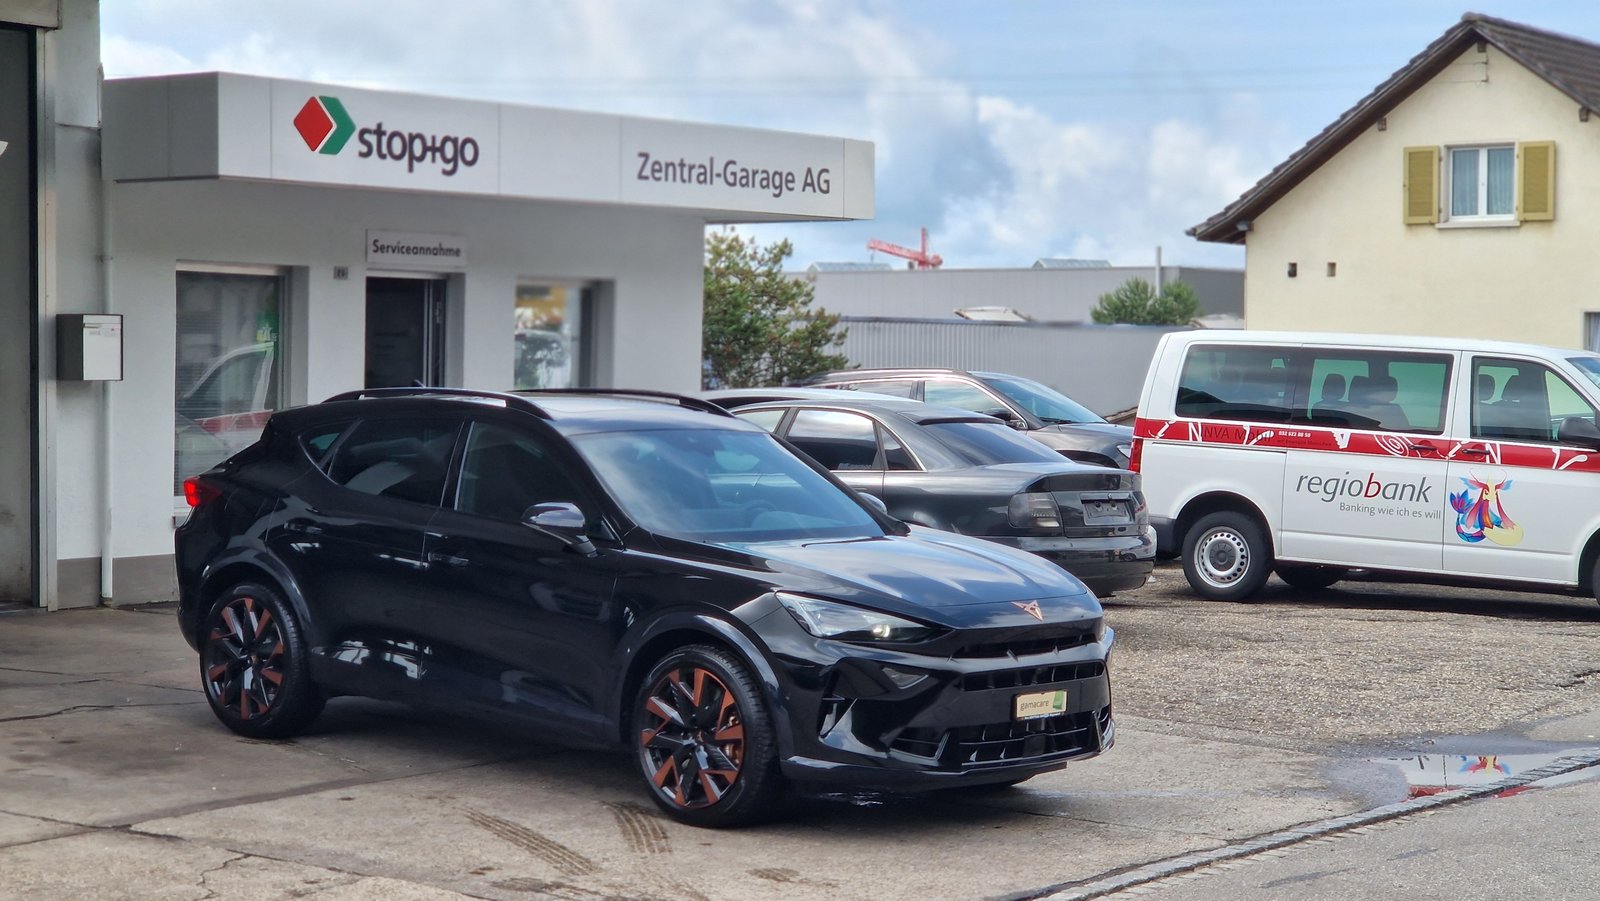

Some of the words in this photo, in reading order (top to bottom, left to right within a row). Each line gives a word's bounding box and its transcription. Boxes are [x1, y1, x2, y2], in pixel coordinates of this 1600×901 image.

[358, 121, 480, 177] stop+go
[637, 151, 796, 198] Zentral-Garage
[801, 166, 831, 195] AG
[372, 238, 461, 257] Serviceannahme
[1296, 472, 1432, 503] regiobank
[1339, 503, 1376, 516] Banking
[1377, 506, 1393, 516] wie
[1396, 506, 1410, 517] ich
[1412, 510, 1422, 518] es
[1424, 509, 1441, 520] will
[1020, 700, 1049, 711] gamacare
